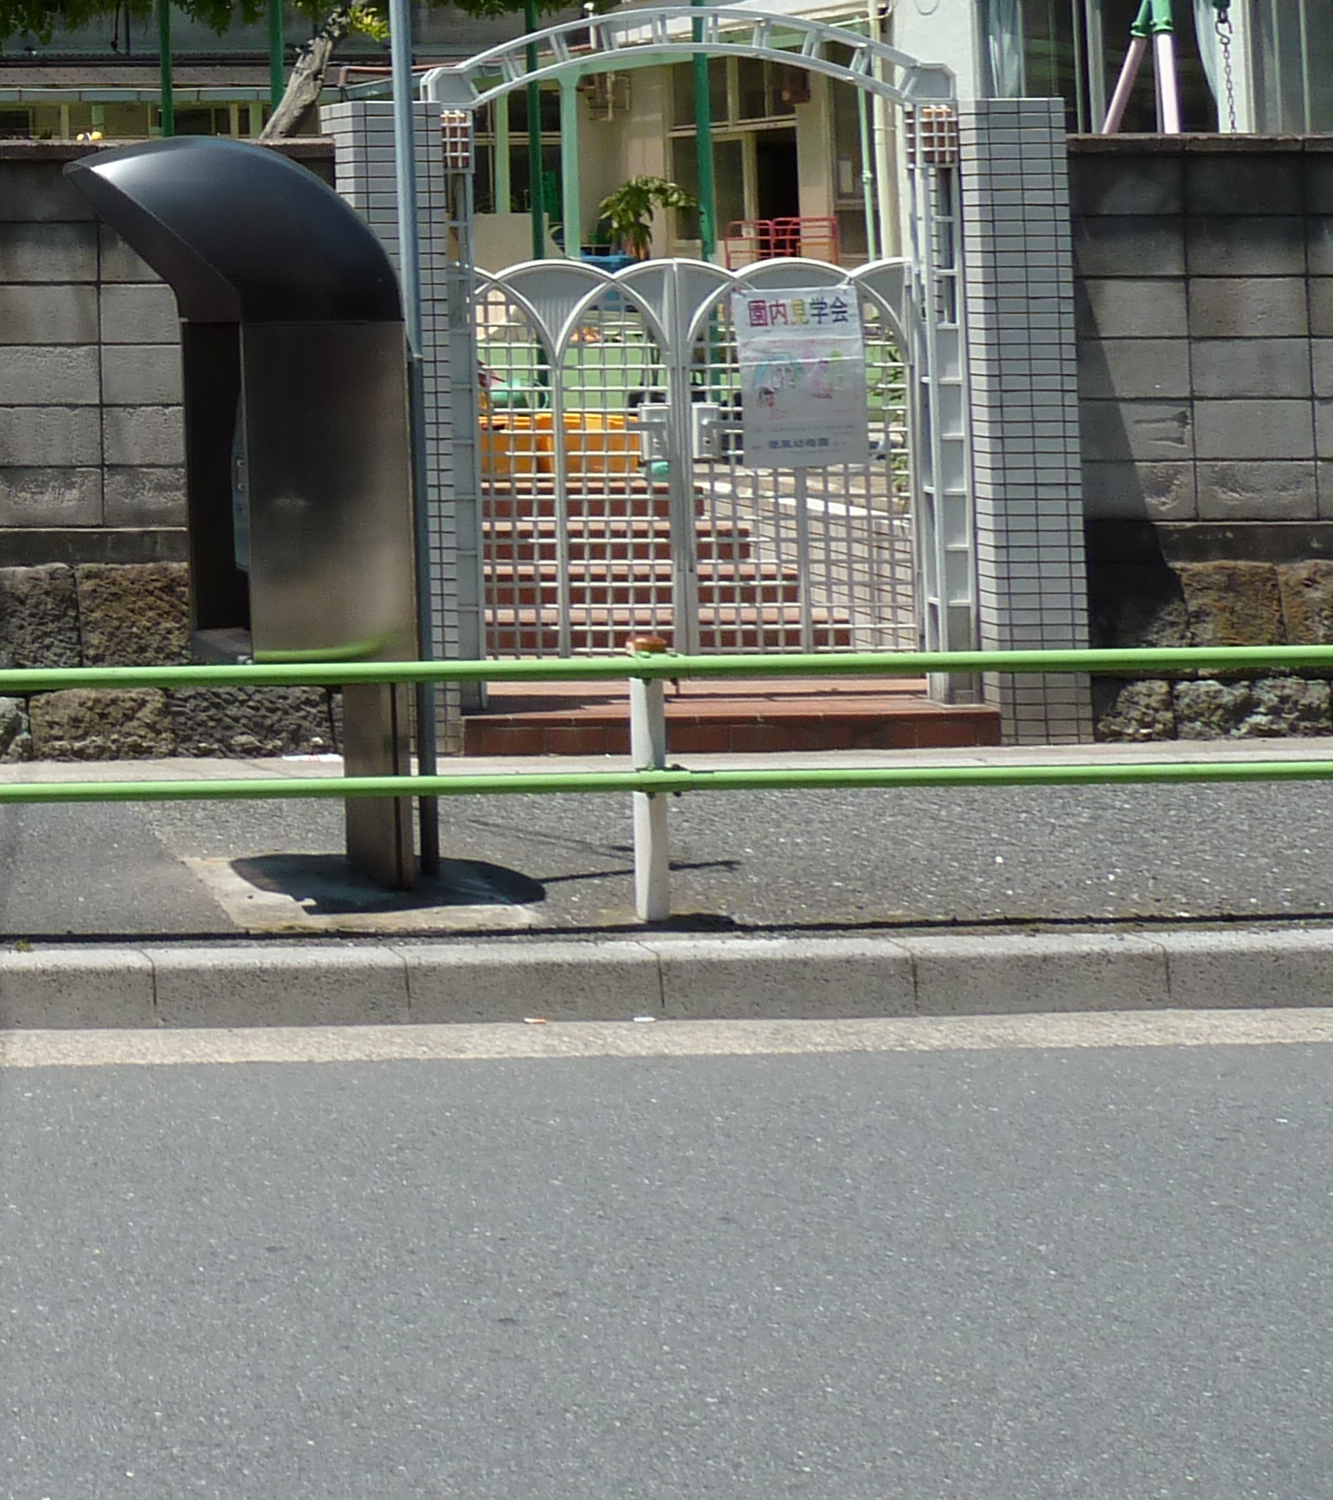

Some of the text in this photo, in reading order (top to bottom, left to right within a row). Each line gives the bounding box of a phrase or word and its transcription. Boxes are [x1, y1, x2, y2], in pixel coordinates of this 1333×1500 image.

[747, 295, 850, 328] 園内見学会
